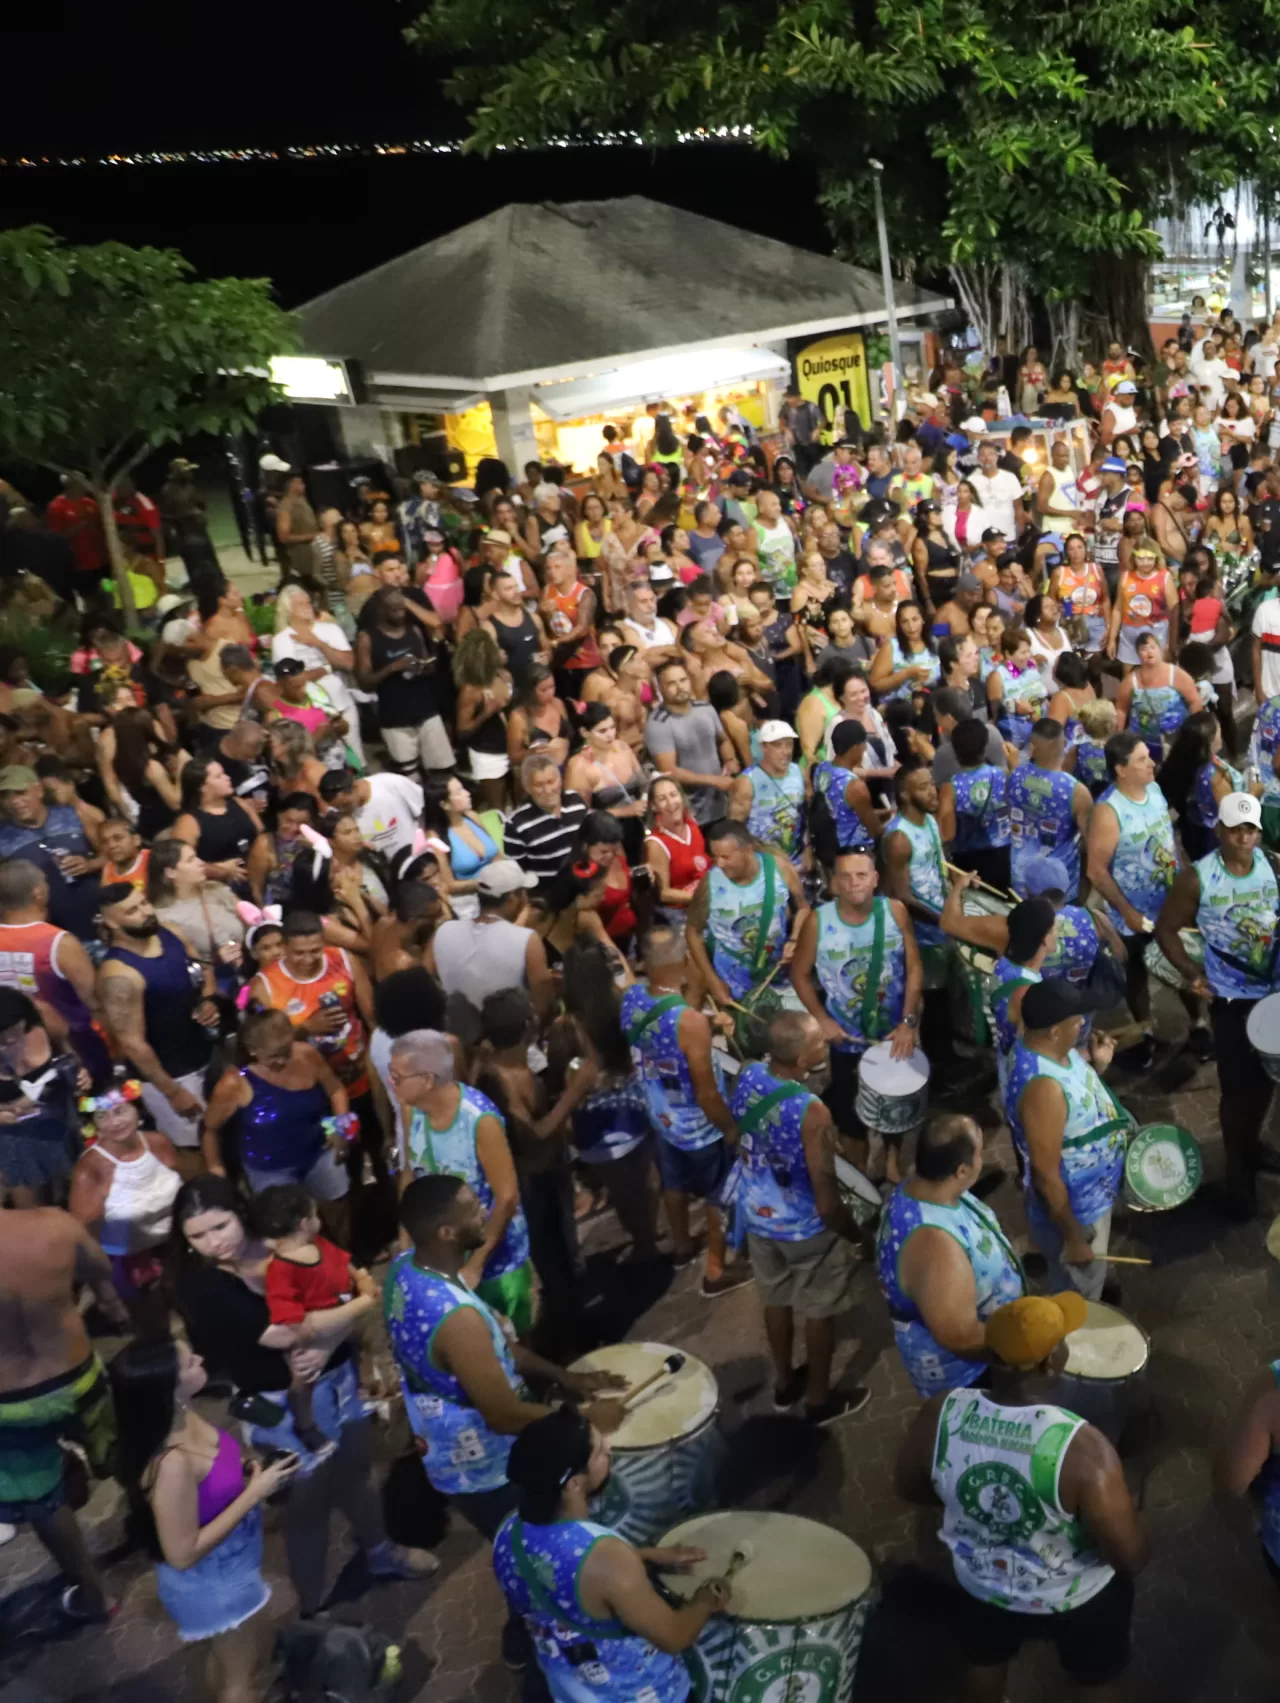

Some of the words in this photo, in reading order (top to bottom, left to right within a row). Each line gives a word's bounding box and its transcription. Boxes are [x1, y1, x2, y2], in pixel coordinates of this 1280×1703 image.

[802, 354, 861, 381] Quiosque
[818, 380, 852, 431] 01
[970, 1414, 1032, 1440] BATERIA
